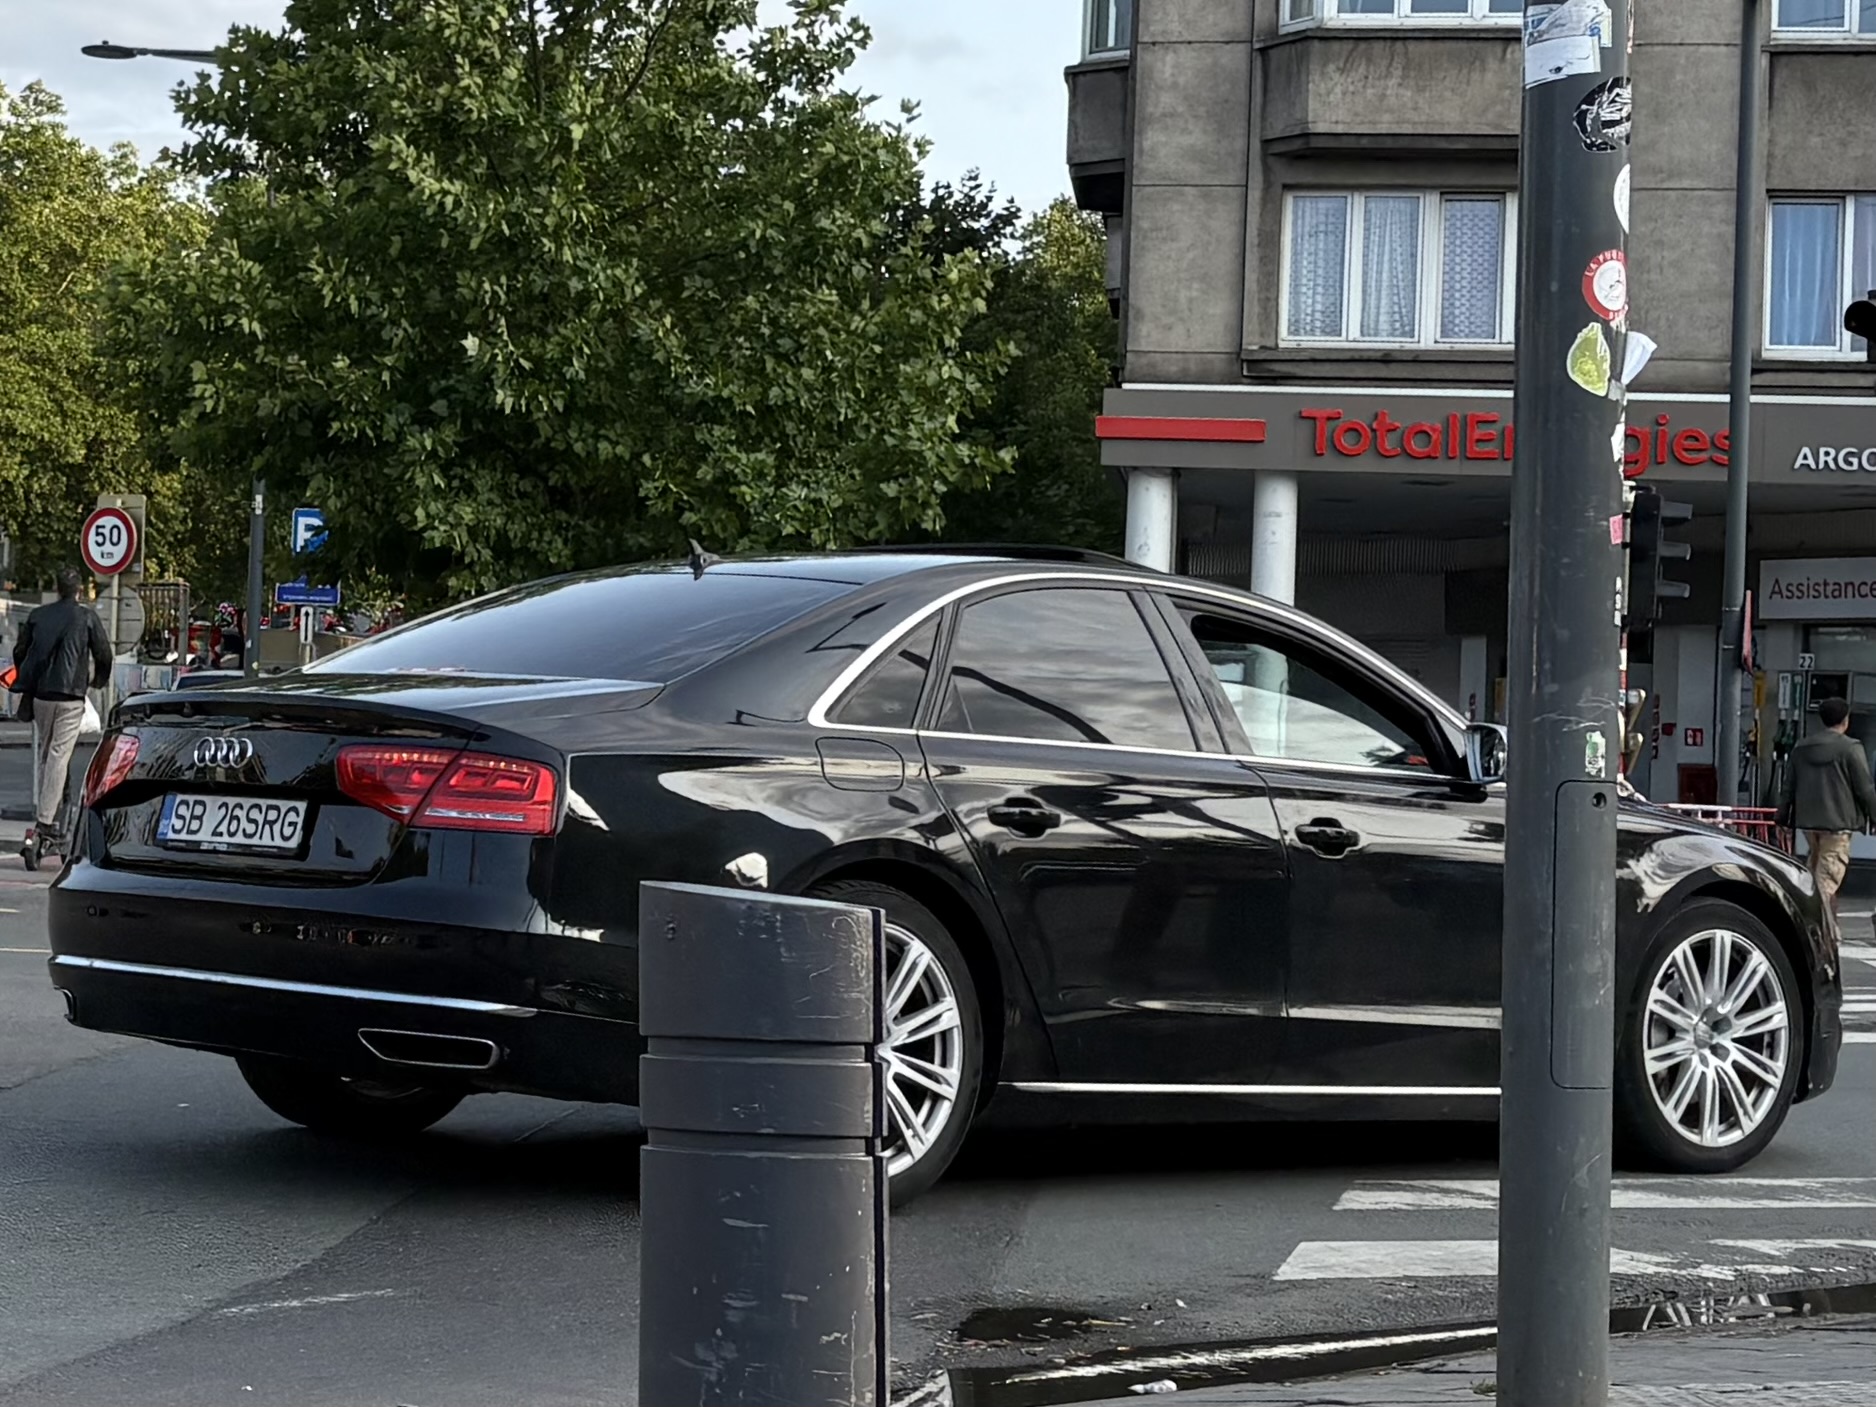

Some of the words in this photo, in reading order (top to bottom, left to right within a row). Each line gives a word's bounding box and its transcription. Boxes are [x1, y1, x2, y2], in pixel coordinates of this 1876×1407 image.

[1299, 408, 1729, 478] TotalEgies
[95, 524, 122, 547] 50
[1799, 656, 1814, 669] 22
[171, 799, 207, 836] SB
[211, 801, 300, 842] 26SRG
